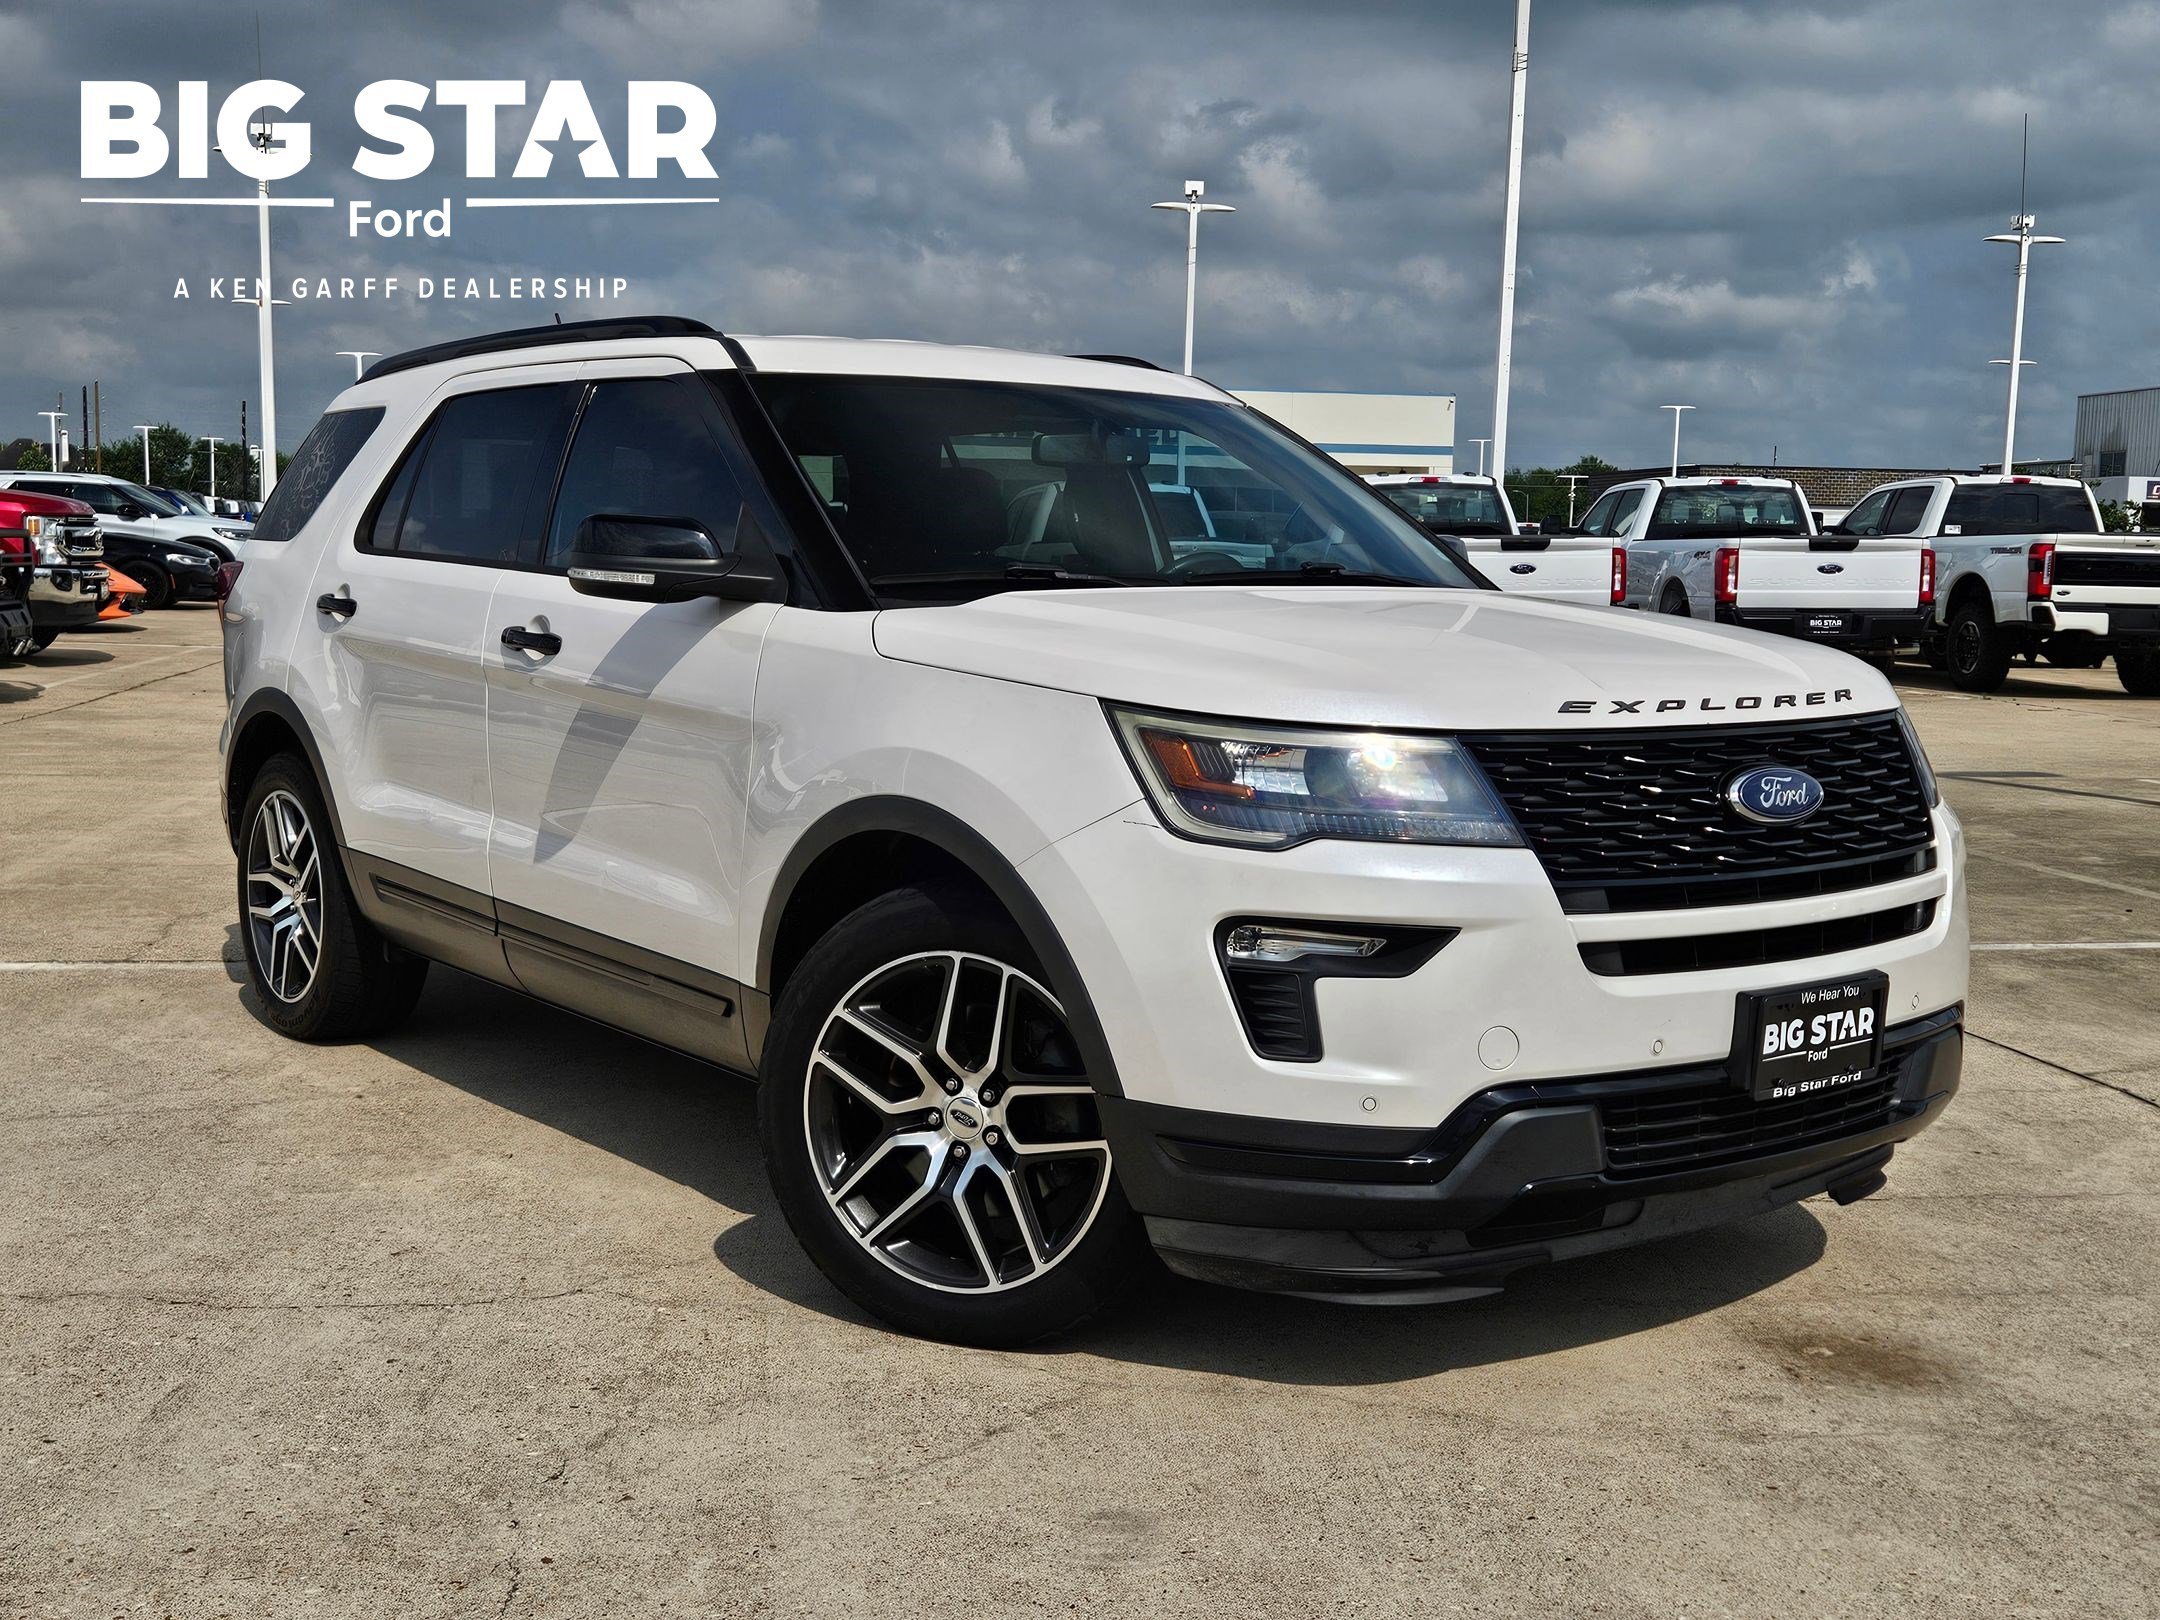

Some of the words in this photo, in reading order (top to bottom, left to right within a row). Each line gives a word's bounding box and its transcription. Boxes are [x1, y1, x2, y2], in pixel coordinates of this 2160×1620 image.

[1810, 619, 1823, 627] BIG
[1823, 619, 1842, 627] STAR
[1557, 688, 1853, 714] EXPLORER
[1760, 776, 1810, 809] Ford
[1801, 991, 1816, 1005] We
[1819, 987, 1841, 1002] Hear
[1843, 985, 1860, 999] You
[1763, 1019, 1805, 1055] BIG
[1810, 1007, 1875, 1045] STAR
[1807, 1047, 1828, 1063] Ford
[1773, 1086, 1796, 1099] Big
[1800, 1079, 1828, 1092] Star
[1831, 1071, 1862, 1086] Ford
